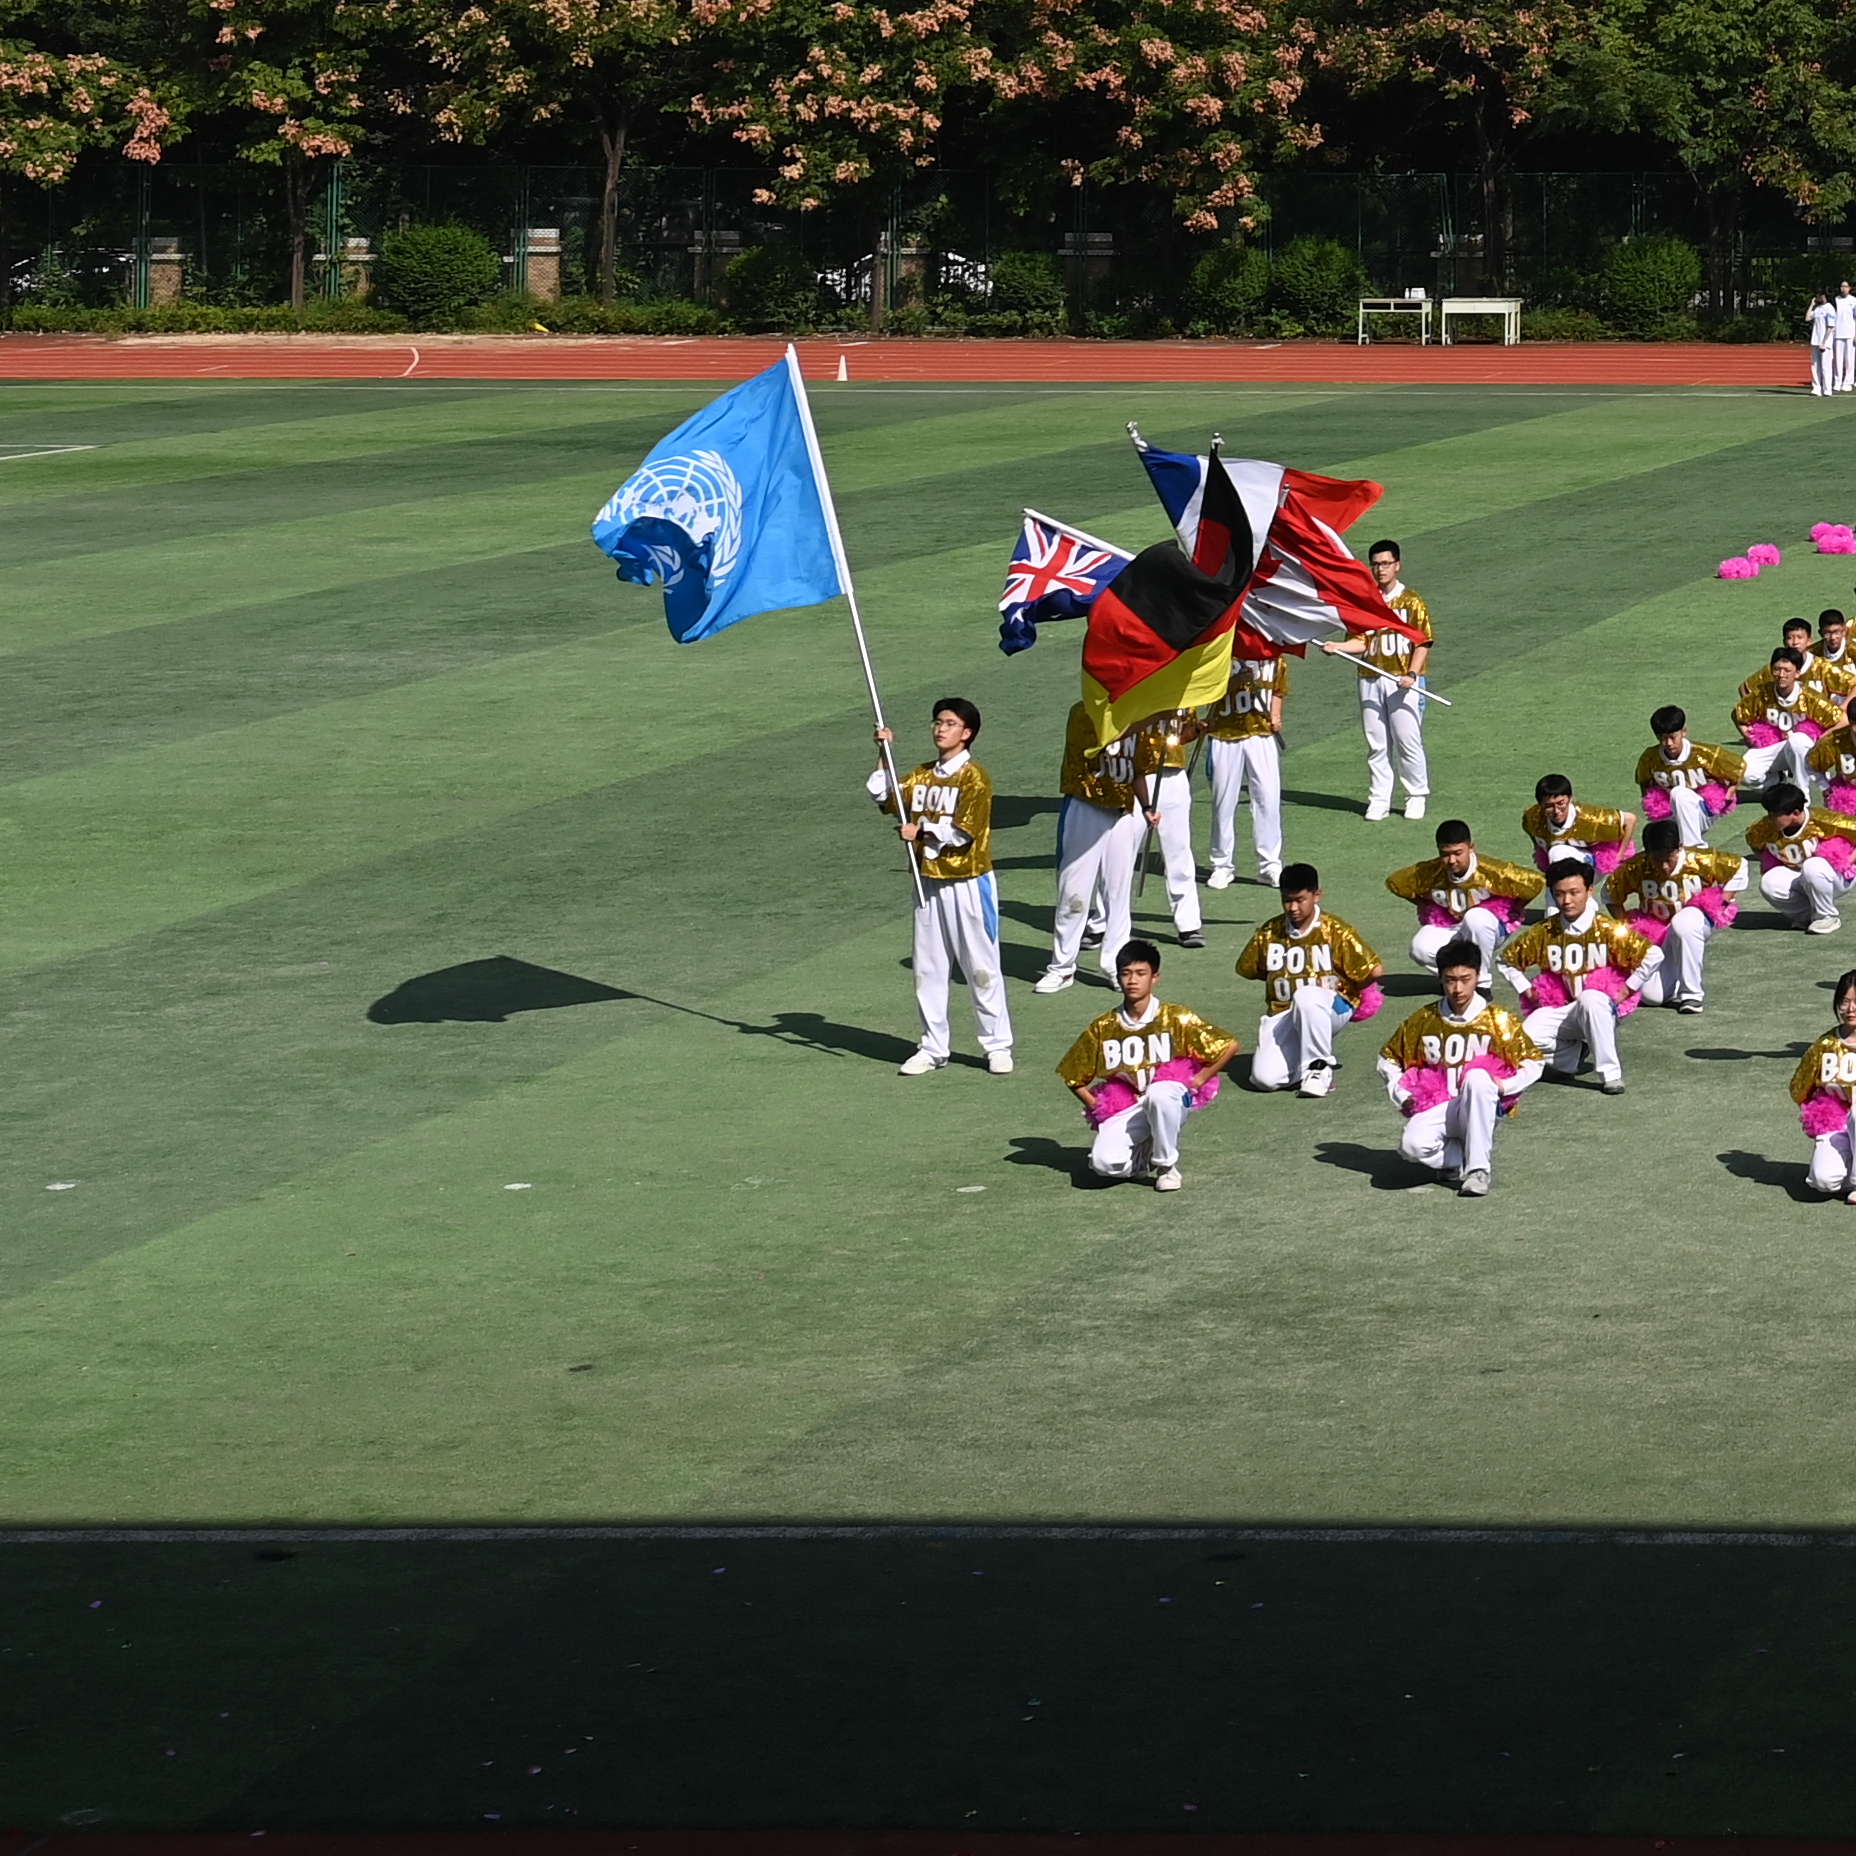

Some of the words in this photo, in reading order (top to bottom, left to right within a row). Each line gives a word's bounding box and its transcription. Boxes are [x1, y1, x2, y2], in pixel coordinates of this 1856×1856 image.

[1653, 768, 1708, 790] BON
[912, 784, 959, 814] BON
[1267, 943, 1332, 974] BON
[1548, 943, 1608, 972] BON
[1103, 1033, 1171, 1070] BON
[1422, 1033, 1491, 1065] BON
